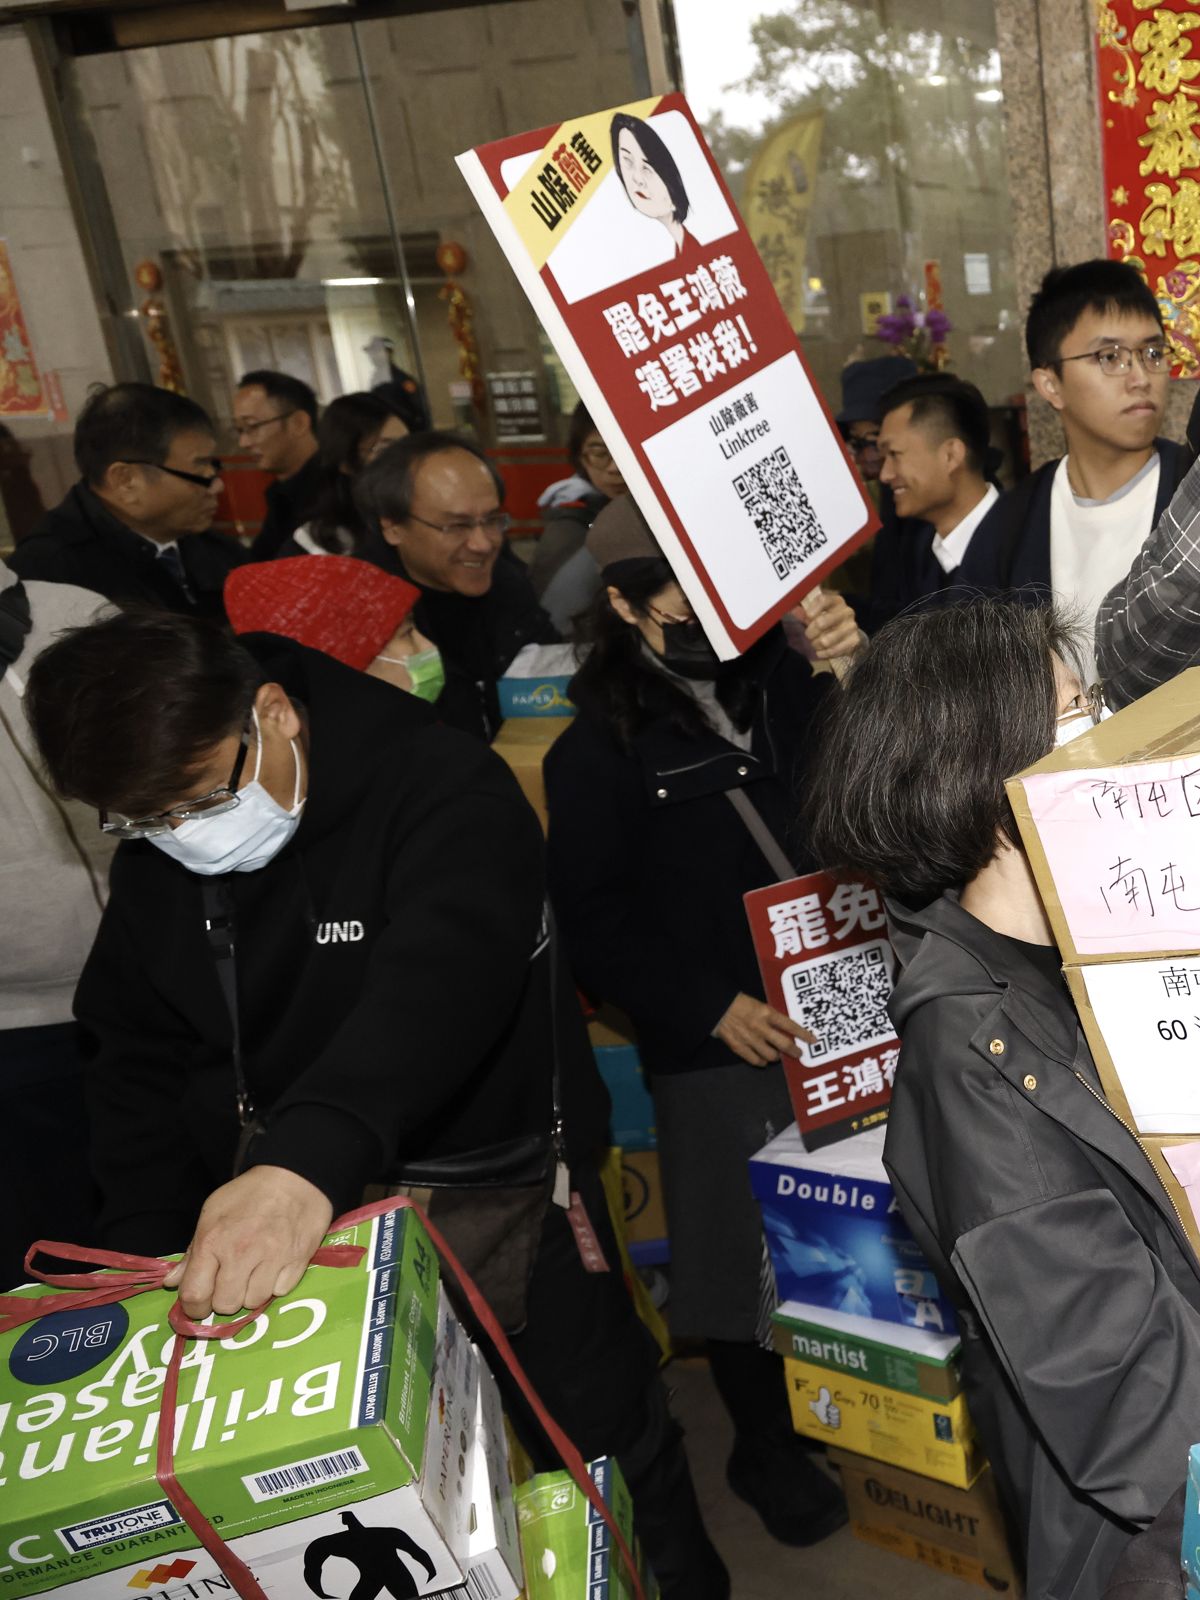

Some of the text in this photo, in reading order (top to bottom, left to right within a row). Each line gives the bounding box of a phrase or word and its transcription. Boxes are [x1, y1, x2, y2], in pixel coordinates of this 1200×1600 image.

[530, 131, 603, 231] 山除薇害
[602, 254, 749, 359] 罷免王鴻薇
[709, 392, 759, 437] 山除薇害
[719, 420, 771, 460] Linktree
[316, 920, 365, 945] UND
[766, 882, 887, 959] 罷免
[1157, 1019, 1188, 1041] 60
[777, 1174, 876, 1211] Double
[380, 1269, 391, 1293] THICKER
[375, 1299, 387, 1326] SHARPER
[26, 1320, 112, 1362] BLC
[371, 1332, 383, 1365] SMOOTHER
[364, 1372, 379, 1420] BETTER OPACITY
[859, 1391, 880, 1410] 70
[0, 1360, 342, 1487] Brillian
[282, 1493, 305, 1503] MADE
[315, 1479, 355, 1495] INDONESIA
[80, 1510, 164, 1540] TRUTONE
[102, 1514, 225, 1558] GUARANTD
